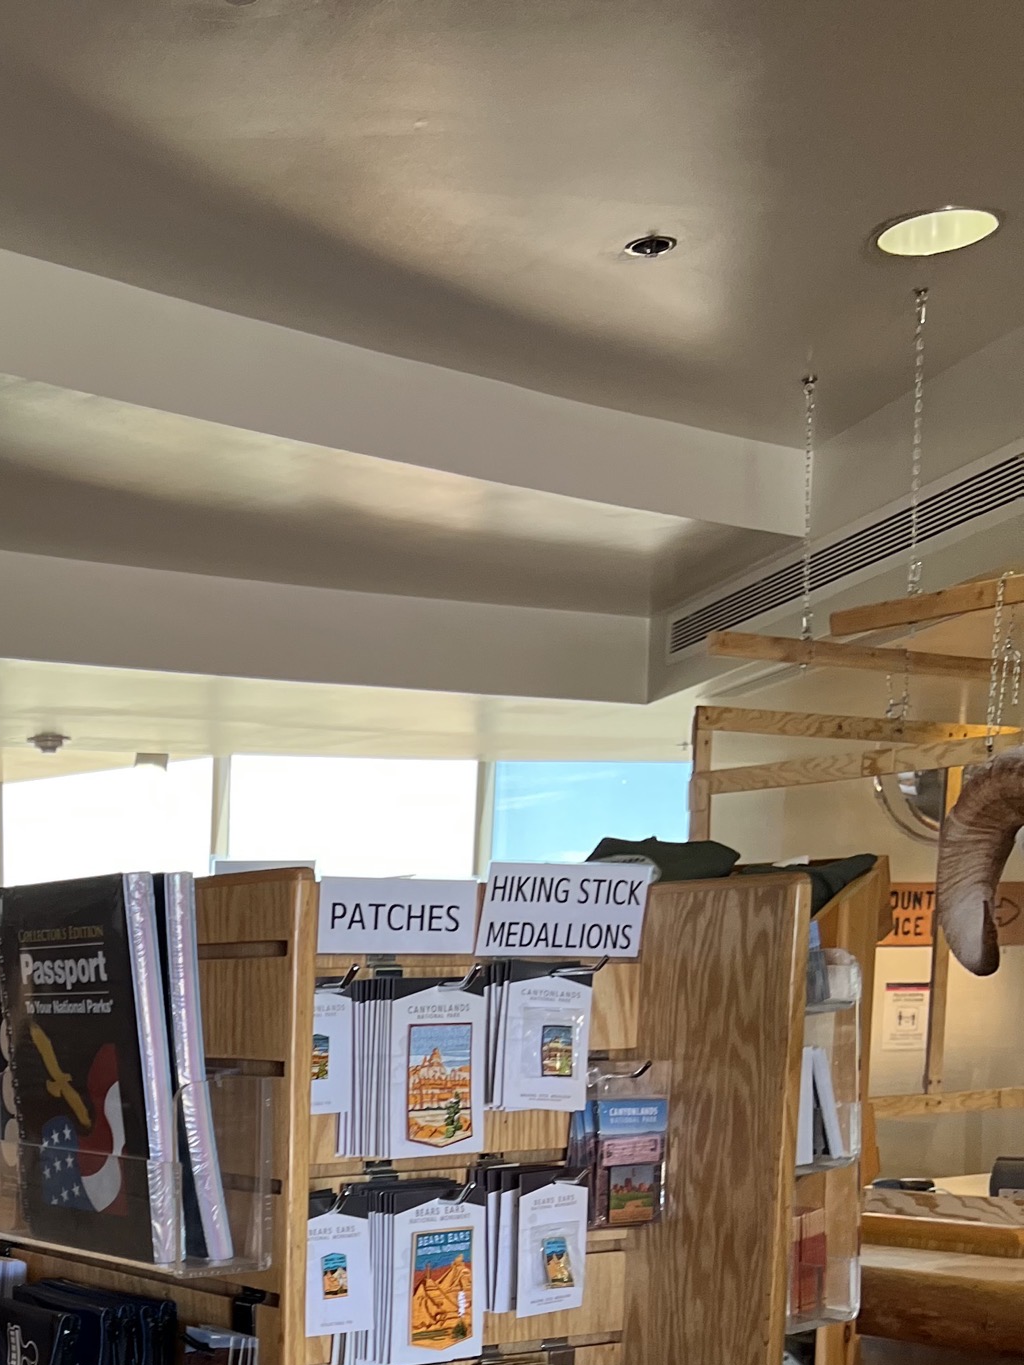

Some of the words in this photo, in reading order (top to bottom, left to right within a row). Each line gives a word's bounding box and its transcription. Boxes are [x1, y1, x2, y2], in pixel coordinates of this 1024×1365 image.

[491, 875, 570, 904] HIKING
[577, 878, 644, 907] STICK
[330, 902, 460, 933] PATCHES
[485, 921, 633, 950] MEDALLIONS
[19, 950, 108, 990] Passport
[24, 1000, 35, 1014] To
[35, 1000, 52, 1014] Your
[52, 999, 86, 1014] National
[407, 1003, 471, 1014] CANYONLANDS
[609, 1106, 658, 1116] CANYONLANDS
[417, 1234, 445, 1247] BEARS
[447, 1231, 471, 1243] EARS
